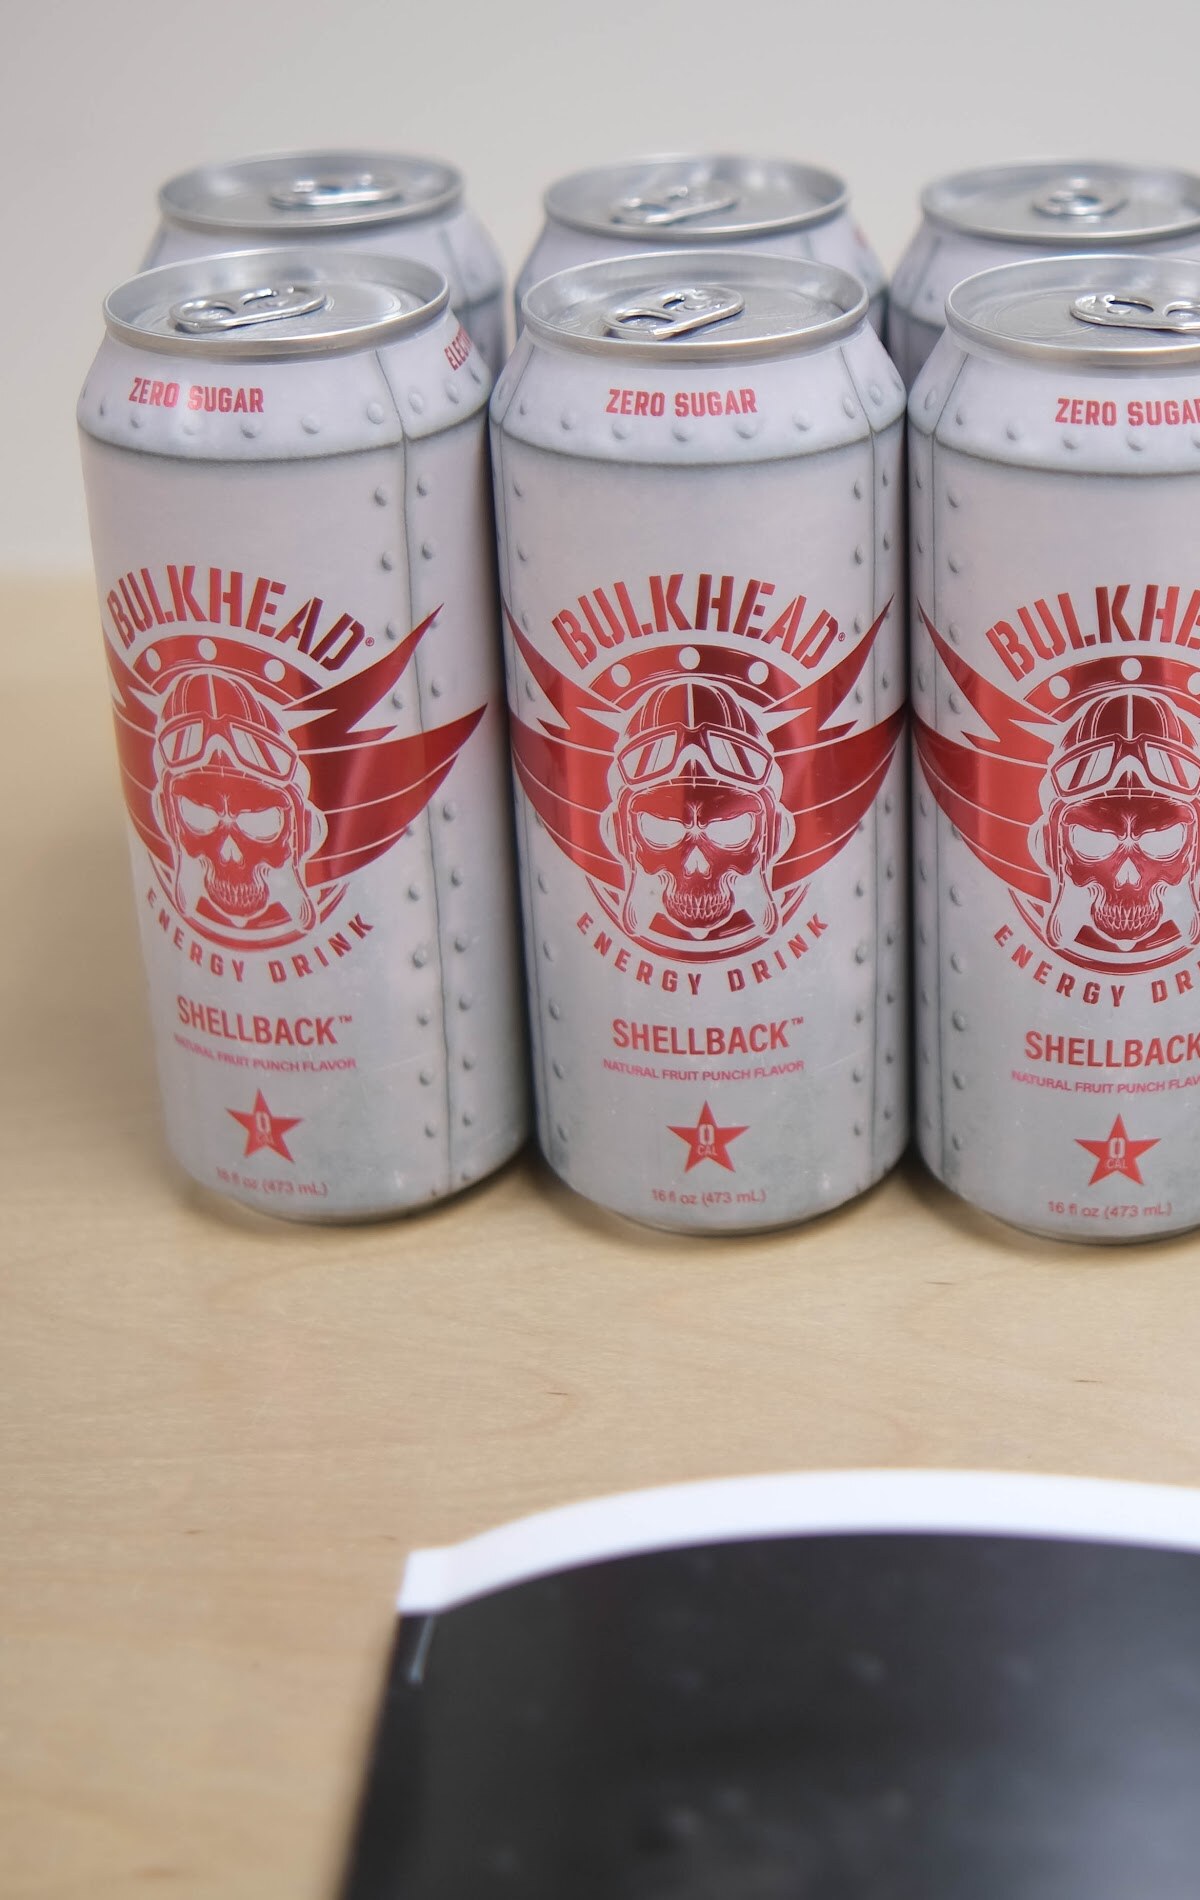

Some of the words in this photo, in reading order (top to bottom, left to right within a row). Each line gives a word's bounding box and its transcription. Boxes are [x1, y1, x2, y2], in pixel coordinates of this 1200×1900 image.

[128, 377, 179, 408] ZERO
[188, 385, 264, 413] SUGAR
[606, 388, 665, 418] ZERO
[674, 387, 757, 418] SUGAR
[1055, 398, 1117, 426] ZERO
[147, 888, 244, 982] ENERGY
[268, 913, 374, 983] DRINK
[576, 912, 702, 995] ENERGY
[729, 913, 829, 993] DRINK
[994, 924, 1125, 1007] ENERGY
[217, 1050, 249, 1067] FRUIT
[253, 1058, 300, 1072] PUNCH
[303, 1058, 357, 1072] FLAVOR
[603, 1058, 660, 1079] NATURAL
[662, 1069, 699, 1081] FRUIT
[702, 1068, 750, 1081] PUNCH
[753, 1060, 805, 1078] FLAVOR
[1011, 1070, 1071, 1091] NATURAL
[1075, 1081, 1114, 1093] FRUIT
[1117, 1081, 1165, 1093] PUNCH
[1109, 1138, 1125, 1159] 0
[1106, 1158, 1128, 1169] CAL
[680, 1193, 697, 1205] oz
[702, 1189, 732, 1207] (473
[1048, 1201, 1064, 1214] 16
[1081, 1207, 1099, 1217] oz
[1104, 1205, 1139, 1219] (473
[1144, 1203, 1172, 1217] mL)
